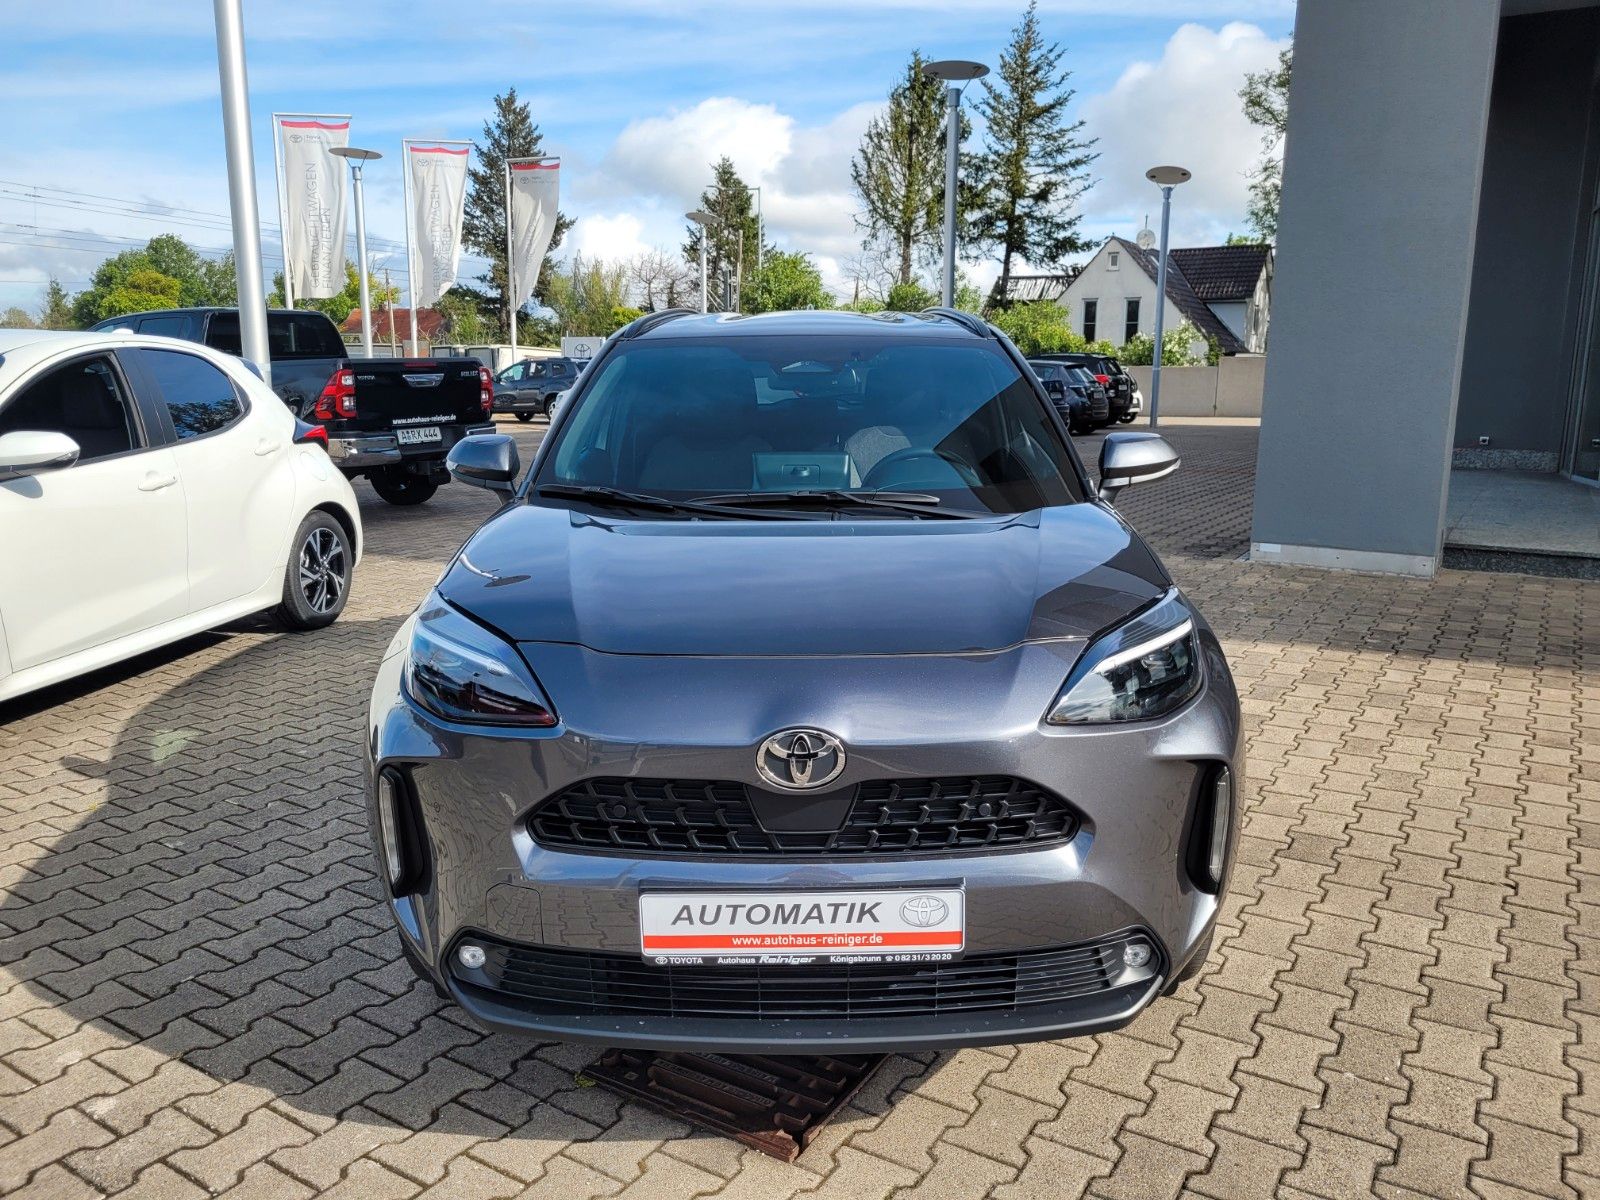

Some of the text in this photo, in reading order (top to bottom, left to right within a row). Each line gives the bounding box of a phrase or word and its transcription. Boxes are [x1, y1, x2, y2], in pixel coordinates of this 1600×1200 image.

[304, 162, 320, 289] GEBRAUCHTWAGEN
[393, 414, 456, 424] www.autohaus-reiniger.de
[411, 430, 422, 440] RX
[424, 428, 437, 438] 444
[671, 902, 882, 926] AUTOMATIK
[732, 933, 883, 947] www.autohaus-reiniger.de
[718, 956, 756, 964] Autohaus
[759, 954, 816, 965] Reiniger
[830, 954, 882, 964] Königsbrunn
